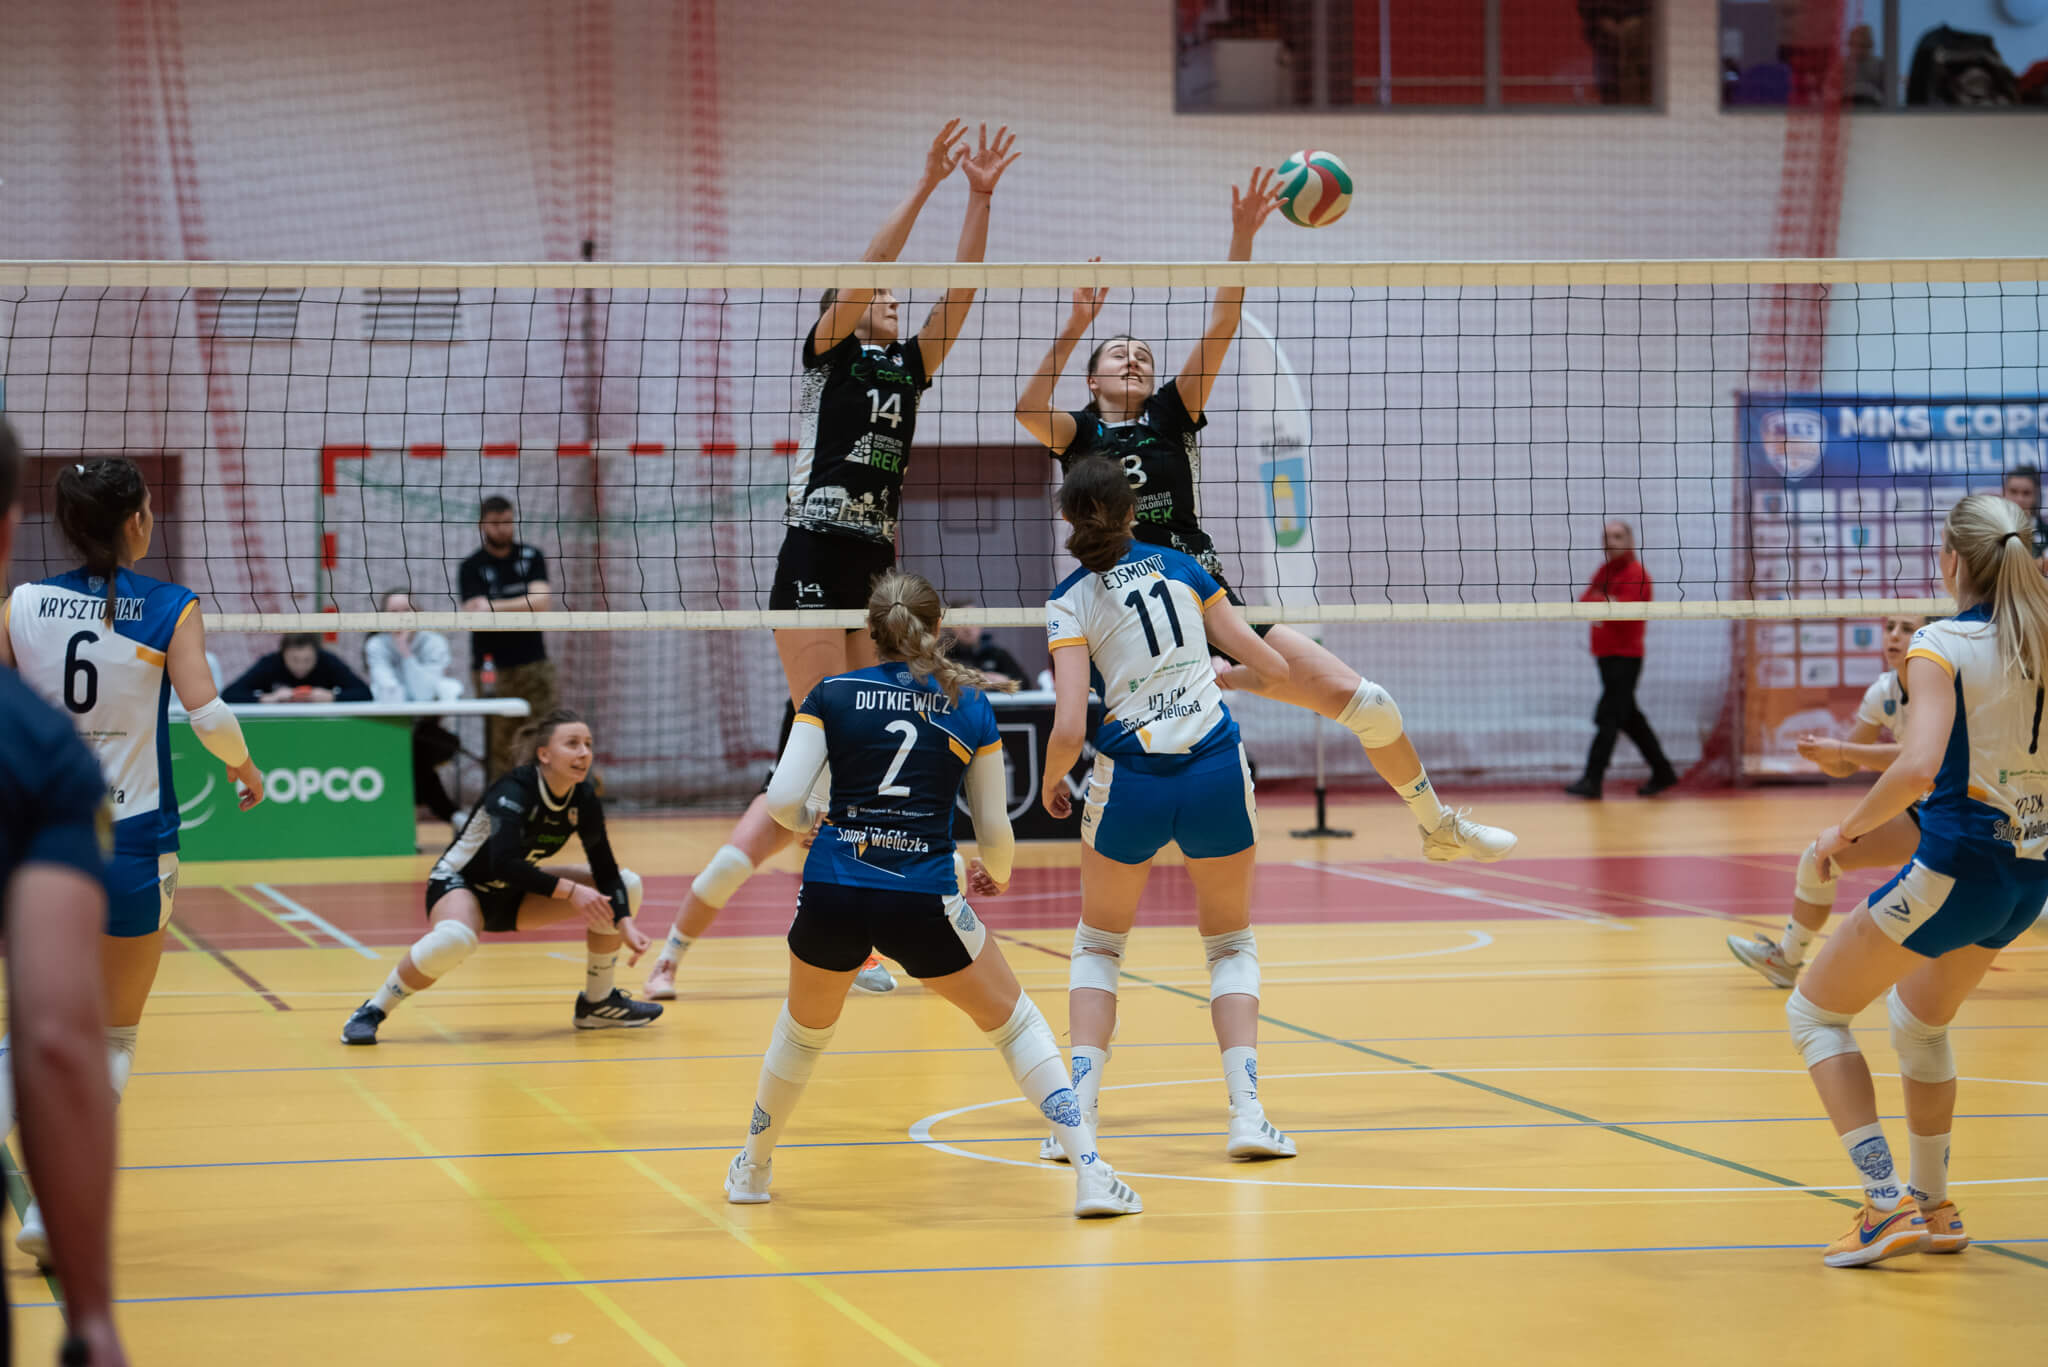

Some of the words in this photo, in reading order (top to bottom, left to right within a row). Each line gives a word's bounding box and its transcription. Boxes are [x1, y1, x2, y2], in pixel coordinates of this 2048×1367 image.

[866, 388, 902, 428] 14
[1839, 405, 1931, 438] MKS
[871, 449, 901, 473] REK
[793, 580, 824, 598] 14
[1101, 553, 1166, 590] EJSMONT
[1124, 579, 1184, 657] 11
[64, 630, 100, 714] 6
[855, 690, 951, 715] DUTKIEWICZ
[878, 720, 918, 797] 2
[238, 767, 385, 803] OPCO
